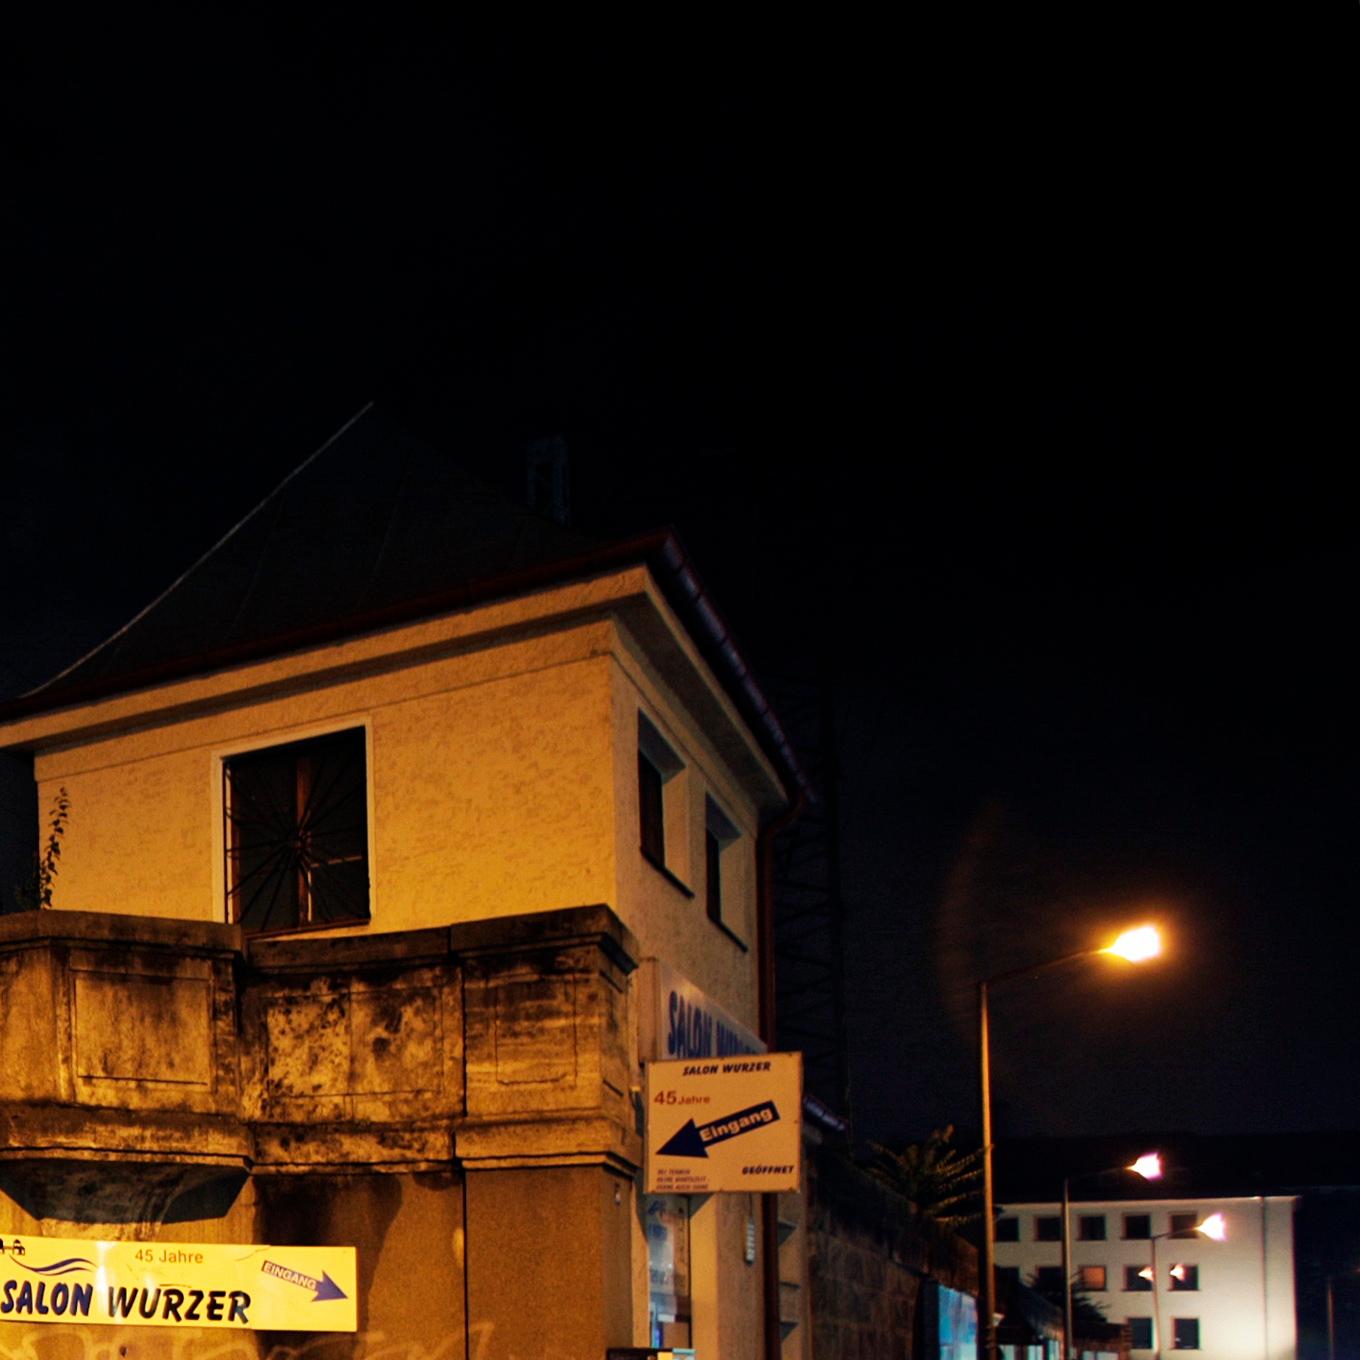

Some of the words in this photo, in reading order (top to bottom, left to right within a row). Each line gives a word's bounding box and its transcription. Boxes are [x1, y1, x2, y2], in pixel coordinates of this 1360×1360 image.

[683, 1065, 719, 1076] SALON
[723, 1061, 772, 1073] WURZER
[654, 1090, 677, 1105] 45
[678, 1096, 710, 1105] Jahre
[700, 1108, 773, 1142] Eingang
[135, 1249, 153, 1262] 45
[159, 1249, 203, 1263] Jahre
[263, 1262, 317, 1290] EINGANG
[0, 1279, 93, 1316] SALON
[108, 1286, 252, 1324] WURZER
